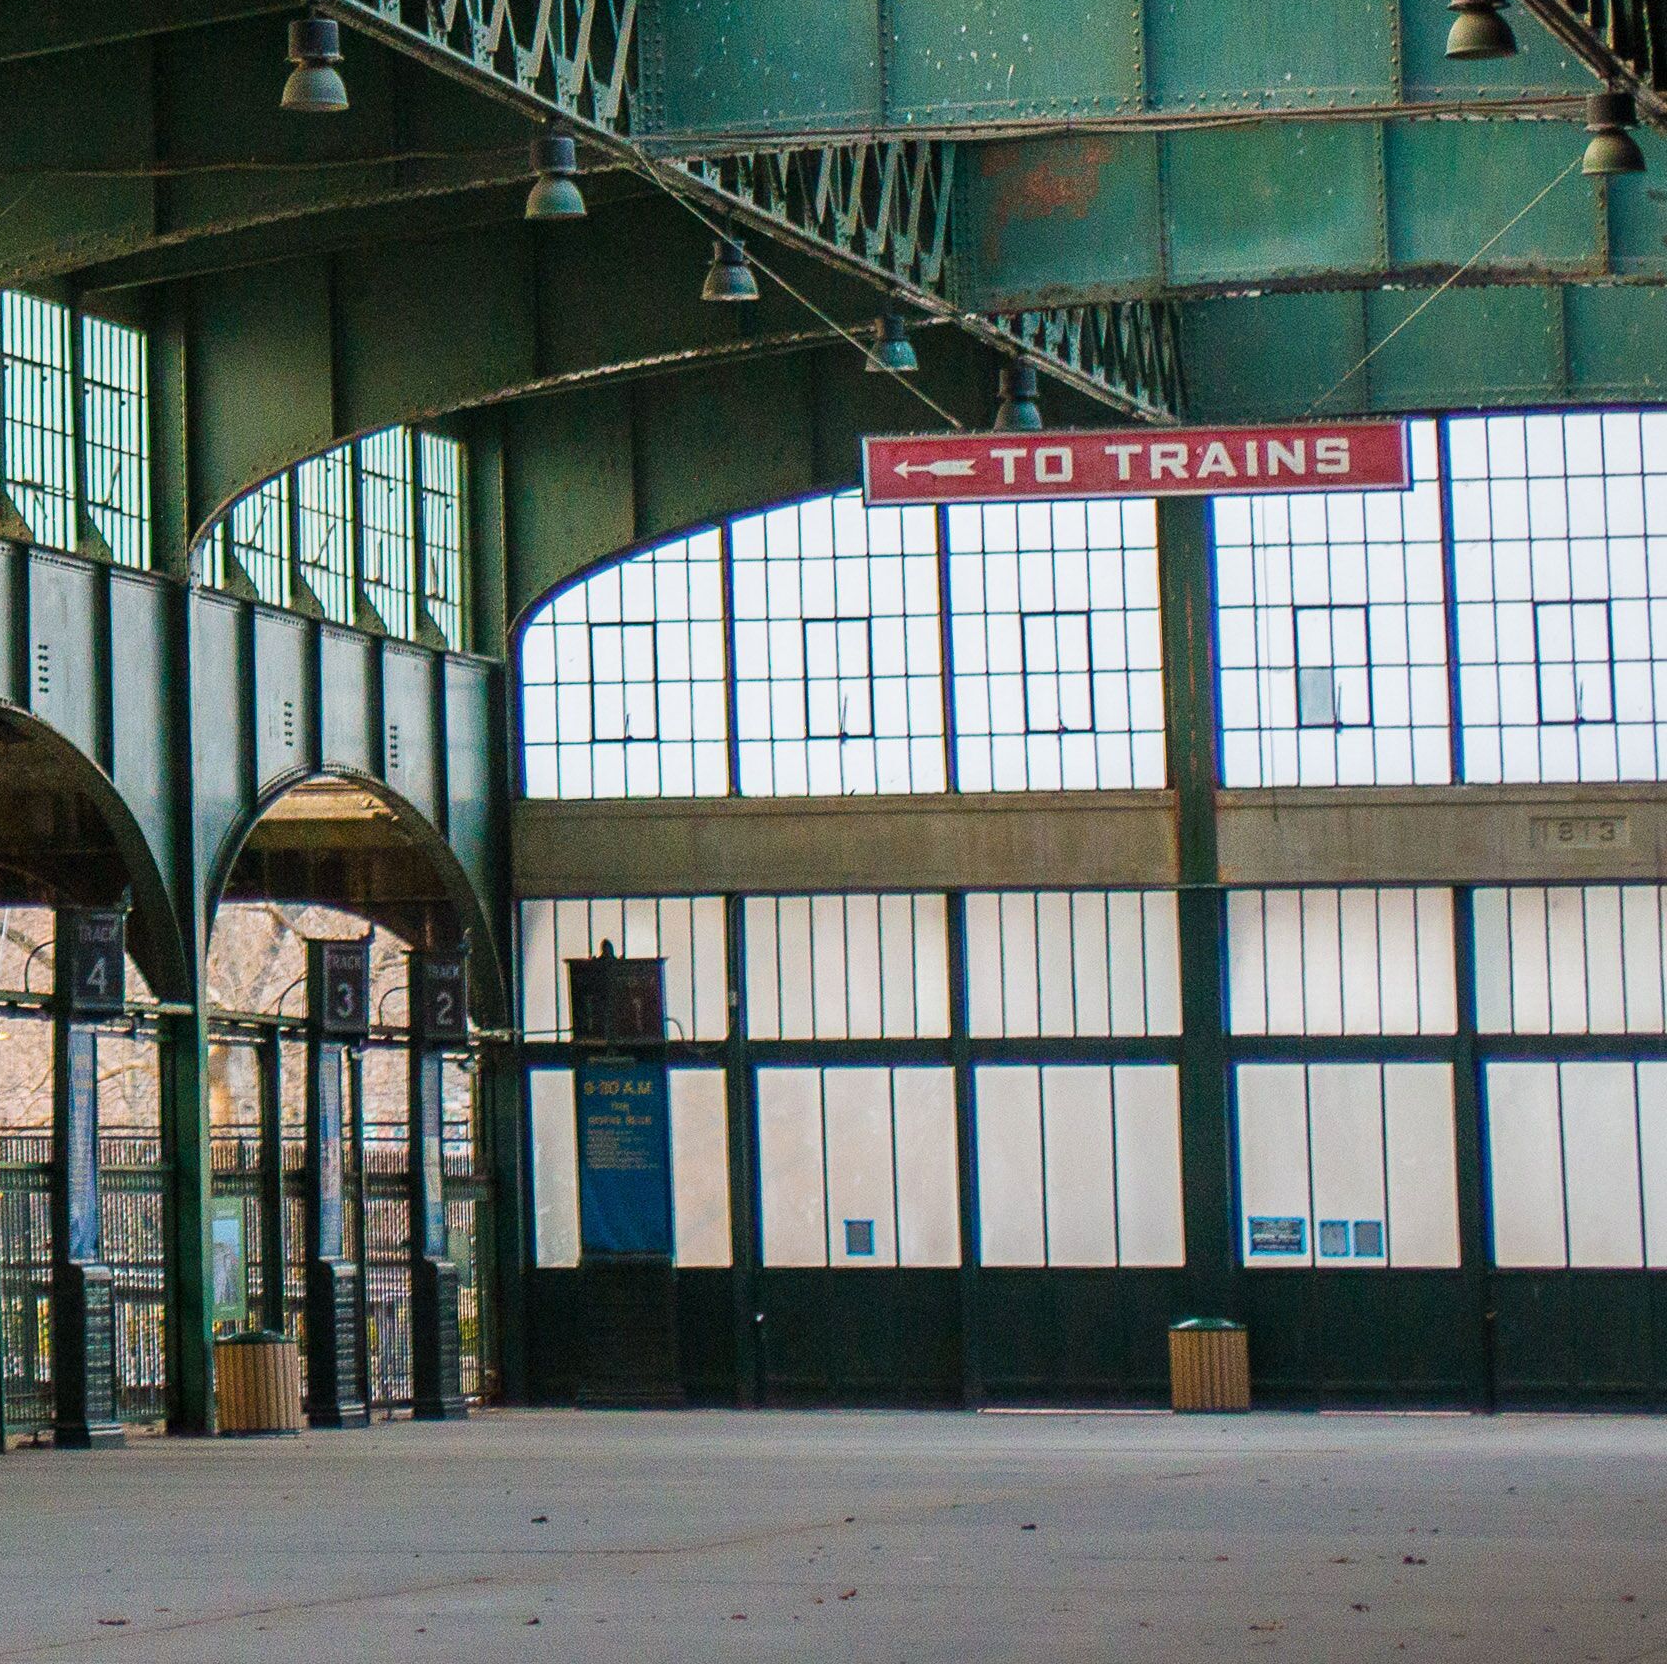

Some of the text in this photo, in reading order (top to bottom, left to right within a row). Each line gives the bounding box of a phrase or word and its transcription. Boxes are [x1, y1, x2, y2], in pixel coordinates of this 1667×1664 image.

[990, 437, 1351, 484] TO TRAINS
[86, 956, 109, 995] 4
[336, 981, 354, 1018] 3
[436, 992, 454, 1026] 2
